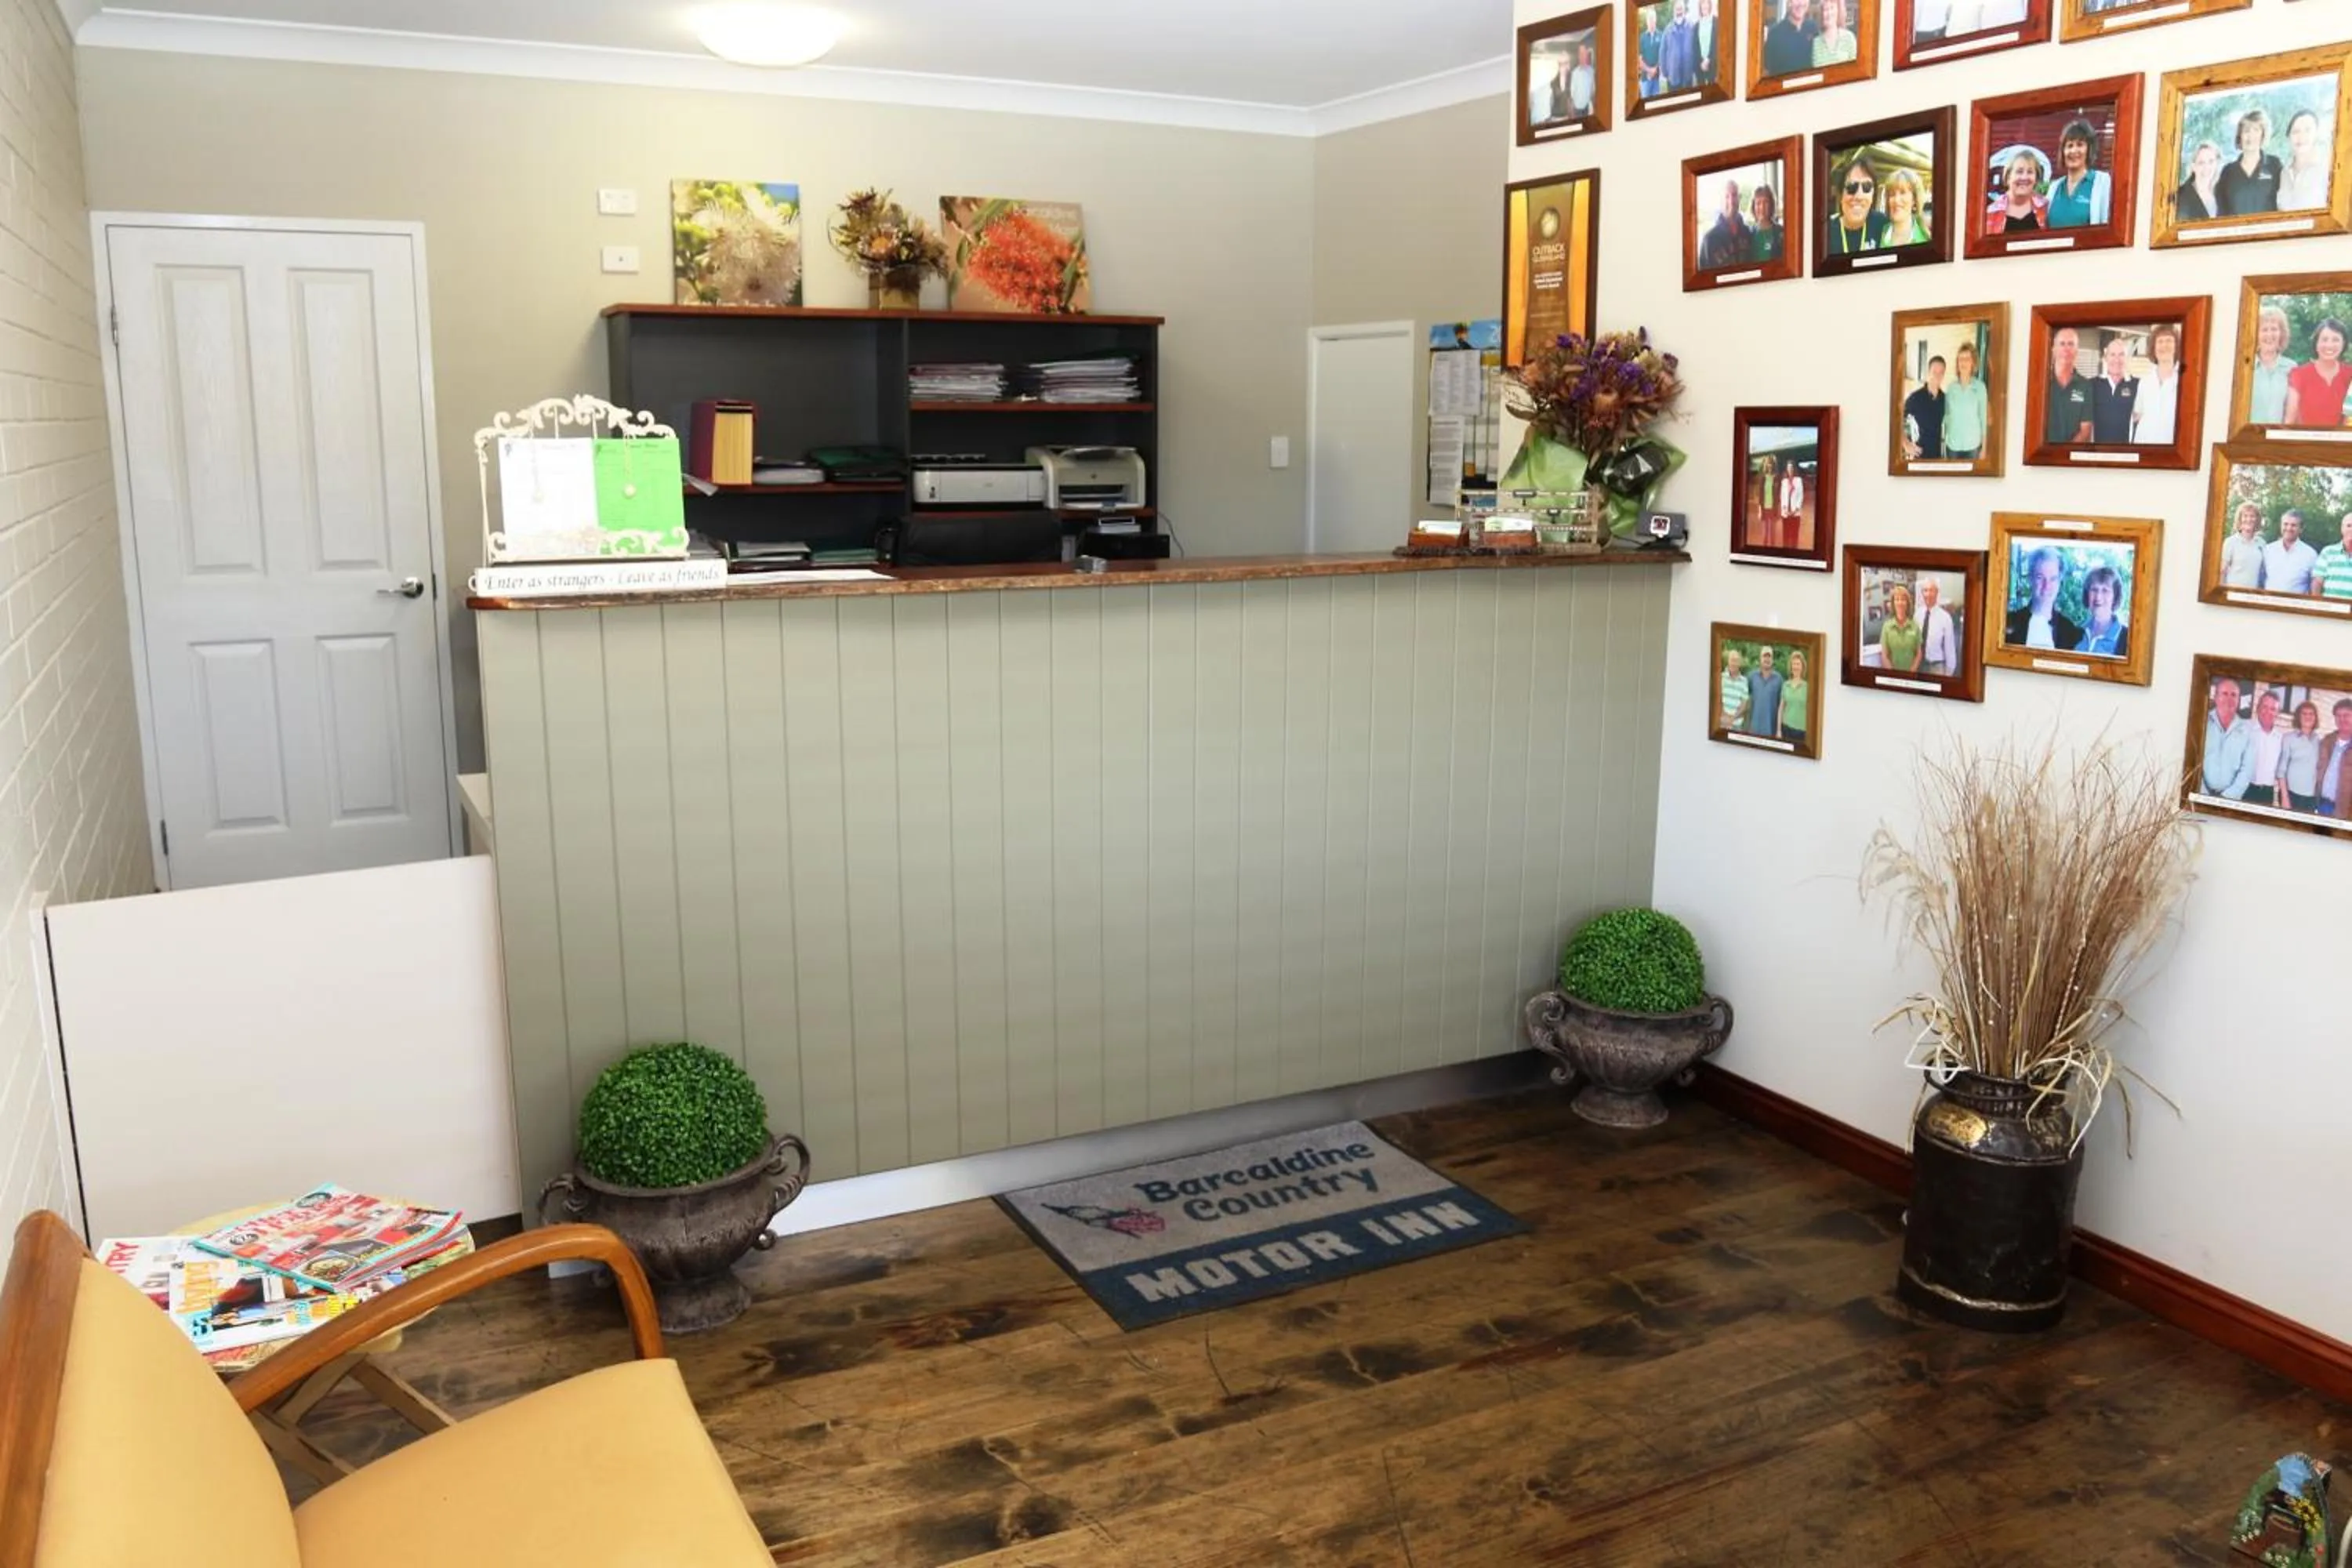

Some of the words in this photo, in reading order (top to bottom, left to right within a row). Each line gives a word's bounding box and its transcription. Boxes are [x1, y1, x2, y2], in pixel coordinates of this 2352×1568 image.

[485, 575, 523, 590] Enter
[528, 576, 542, 588] as
[547, 574, 605, 590] strangers
[618, 571, 655, 585] Leave
[659, 572, 673, 583] as
[676, 564, 720, 586] friends
[1134, 1142, 1375, 1203] Barcaldine
[1183, 1167, 1378, 1221] Country
[1124, 1230, 1363, 1303] MOTOR
[1359, 1201, 1481, 1246] INN
